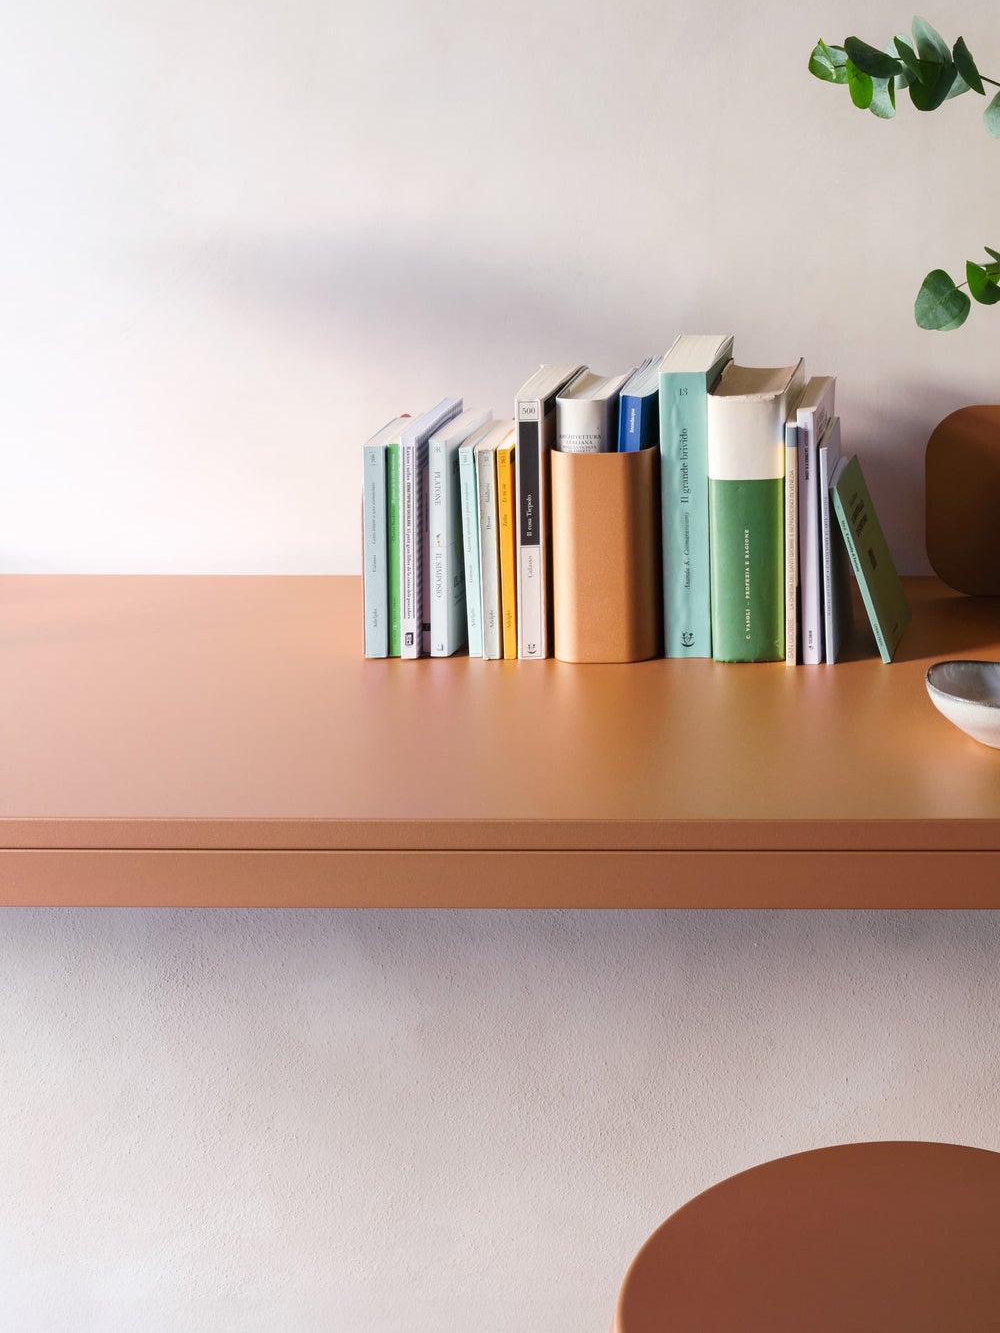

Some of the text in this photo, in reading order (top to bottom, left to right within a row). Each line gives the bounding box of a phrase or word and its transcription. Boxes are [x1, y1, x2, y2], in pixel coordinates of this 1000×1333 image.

[522, 407, 536, 415] 500
[679, 428, 689, 460] brivido
[680, 462, 692, 494] grande
[526, 494, 534, 517] Tiepolo
[436, 553, 442, 561] IL
